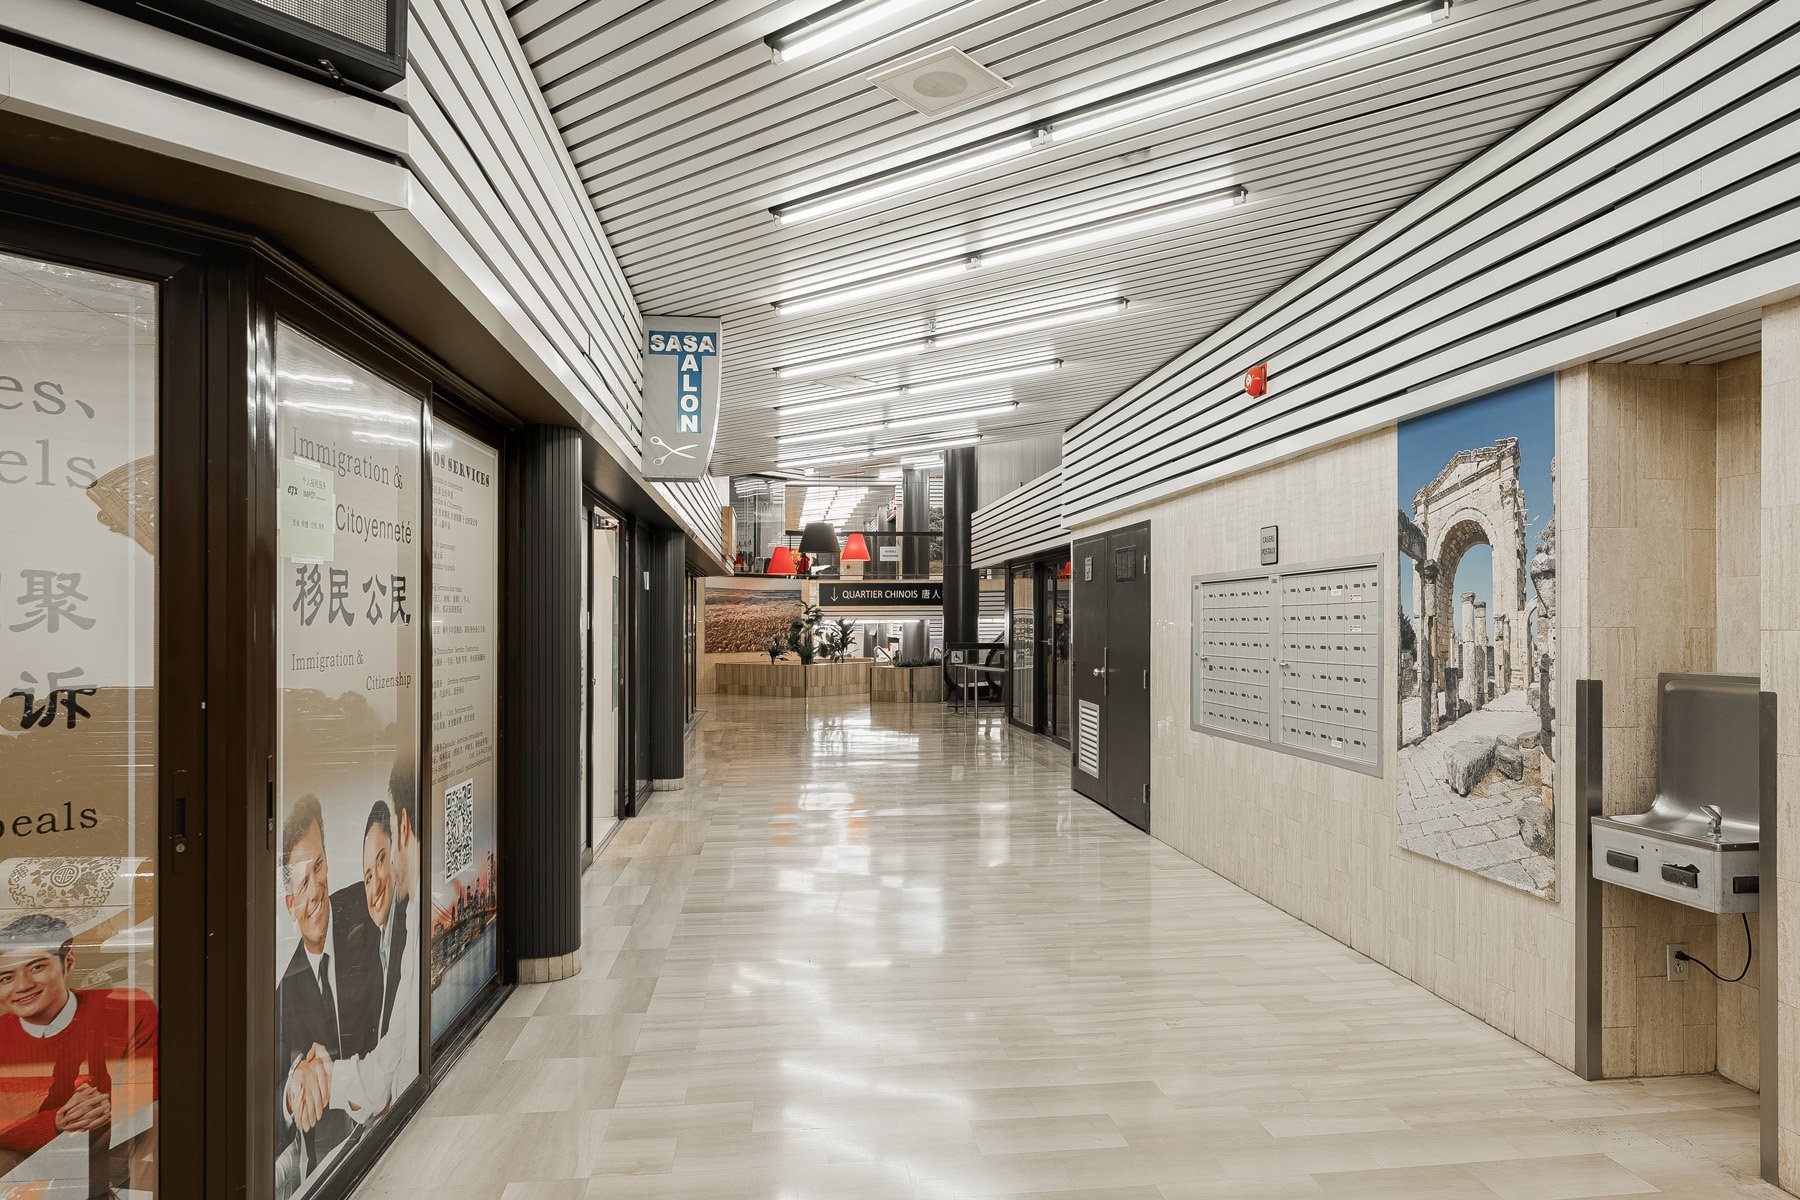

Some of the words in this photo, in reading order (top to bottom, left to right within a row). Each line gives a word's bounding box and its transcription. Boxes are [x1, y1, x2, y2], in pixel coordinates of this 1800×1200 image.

[650, 334, 715, 352] SASA
[0, 438, 97, 491] els
[292, 426, 389, 486] Immigration
[393, 465, 403, 490] &
[447, 457, 490, 487] SERVICES
[335, 503, 412, 544] Citoyenneté
[292, 563, 355, 627] 移民
[362, 574, 411, 627] 公民
[842, 590, 883, 599] QUARTIER
[884, 590, 918, 599] CHINOIS
[921, 589, 943, 599] 唐人
[291, 651, 354, 673] Immigration
[356, 649, 364, 665] &
[9, 666, 97, 729] 诉
[366, 671, 412, 690] Citizenship
[0, 801, 98, 838] eals
